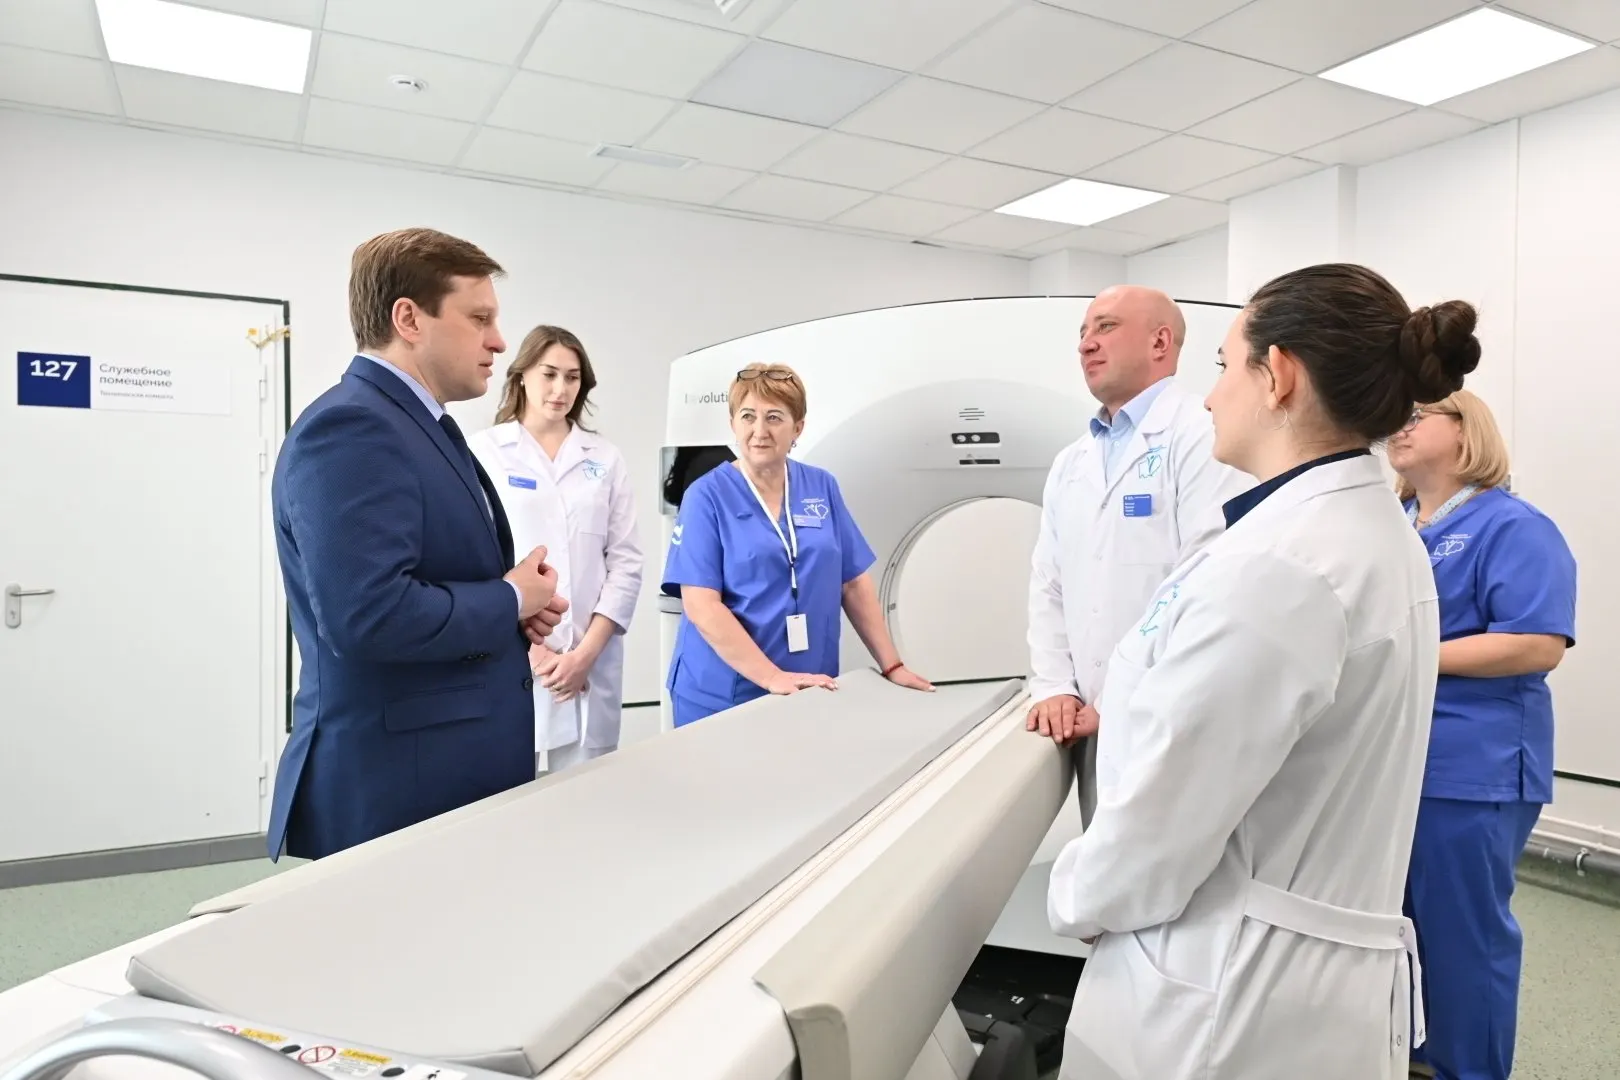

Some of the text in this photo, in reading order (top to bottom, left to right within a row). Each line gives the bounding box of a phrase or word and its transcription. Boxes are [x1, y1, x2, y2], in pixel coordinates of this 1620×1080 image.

[30, 359, 78, 382] 127
[99, 363, 171, 377] Служебное
[99, 376, 173, 388] помещение
